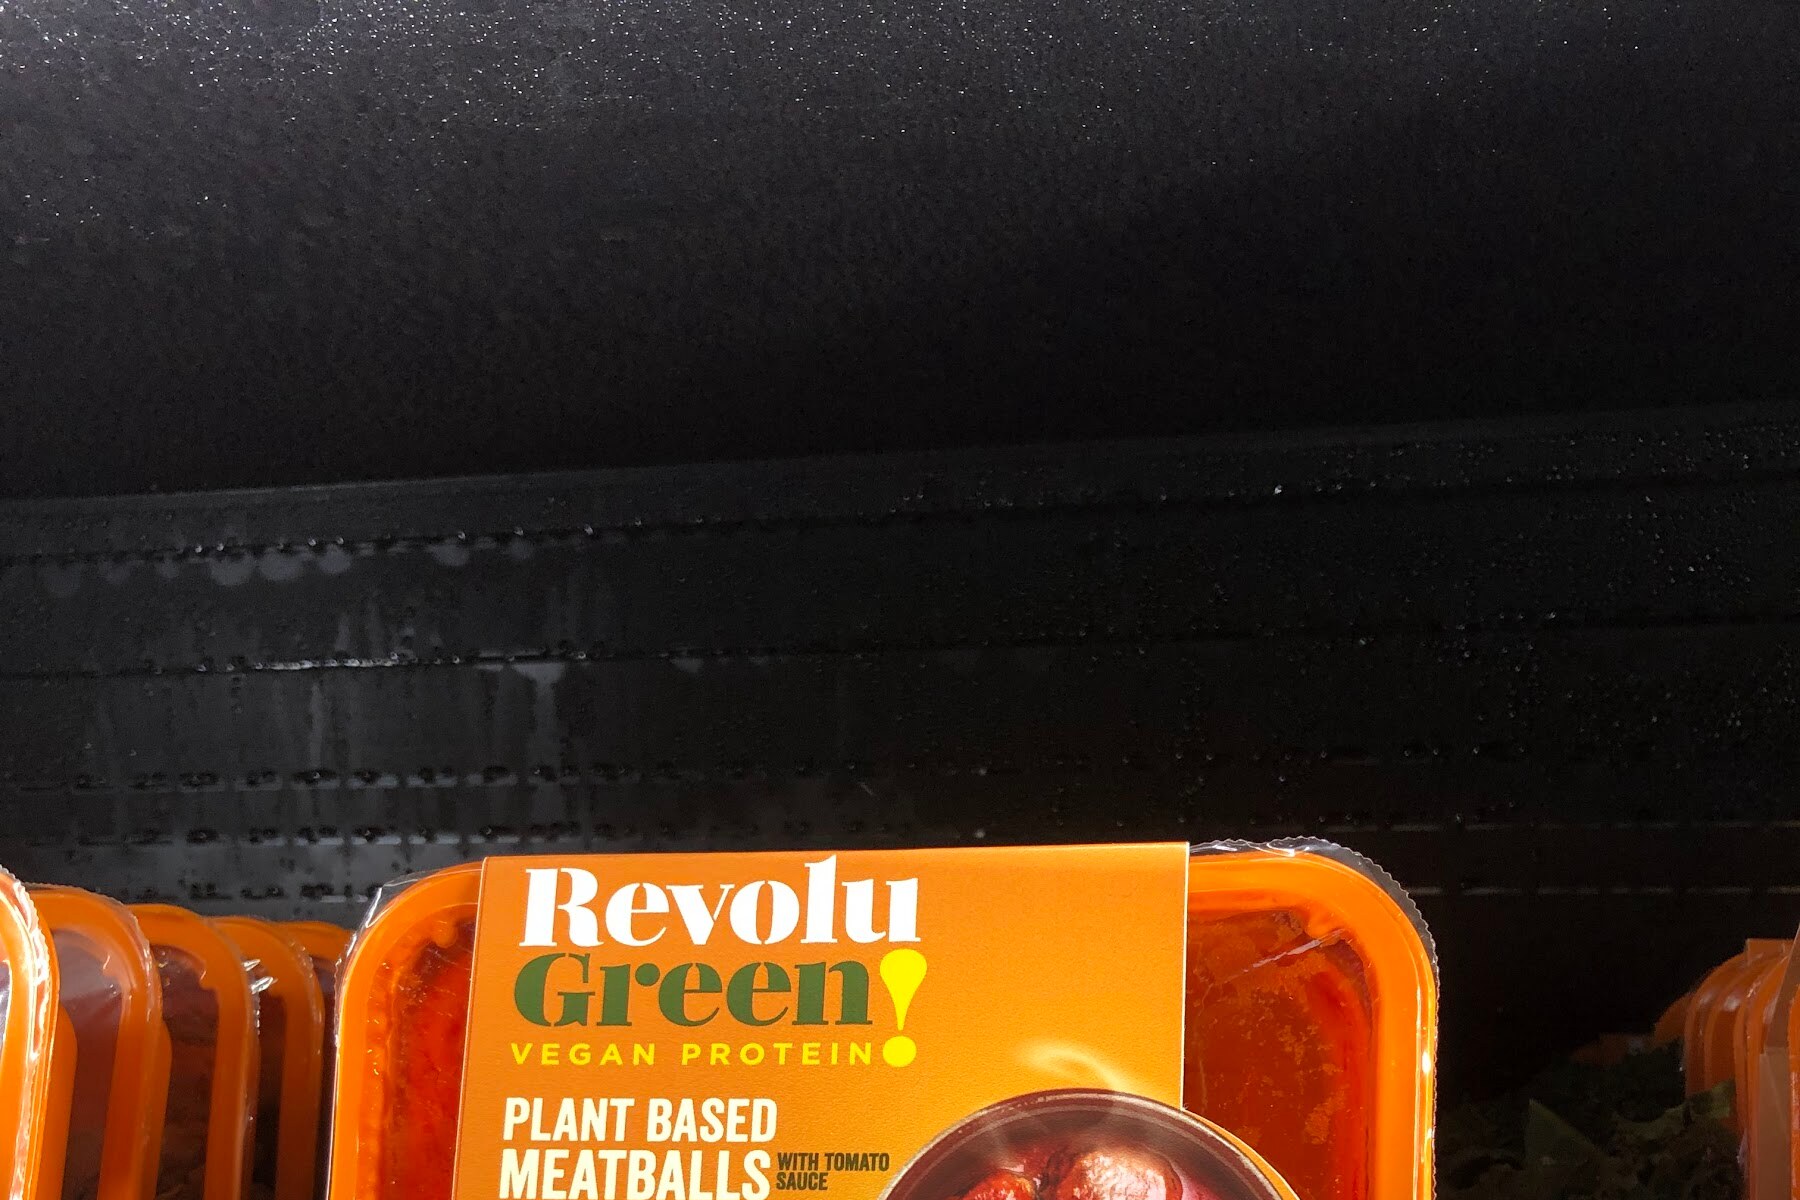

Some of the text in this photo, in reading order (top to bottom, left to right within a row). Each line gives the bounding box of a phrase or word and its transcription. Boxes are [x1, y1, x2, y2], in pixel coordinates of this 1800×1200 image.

[519, 855, 921, 946] Revolu
[511, 1042, 872, 1066] VEGAN PROTEIN
[503, 1098, 777, 1143] PLANT BASED
[777, 1152, 889, 1171] WITH TOMATO
[776, 1172, 828, 1190] SAUCE
